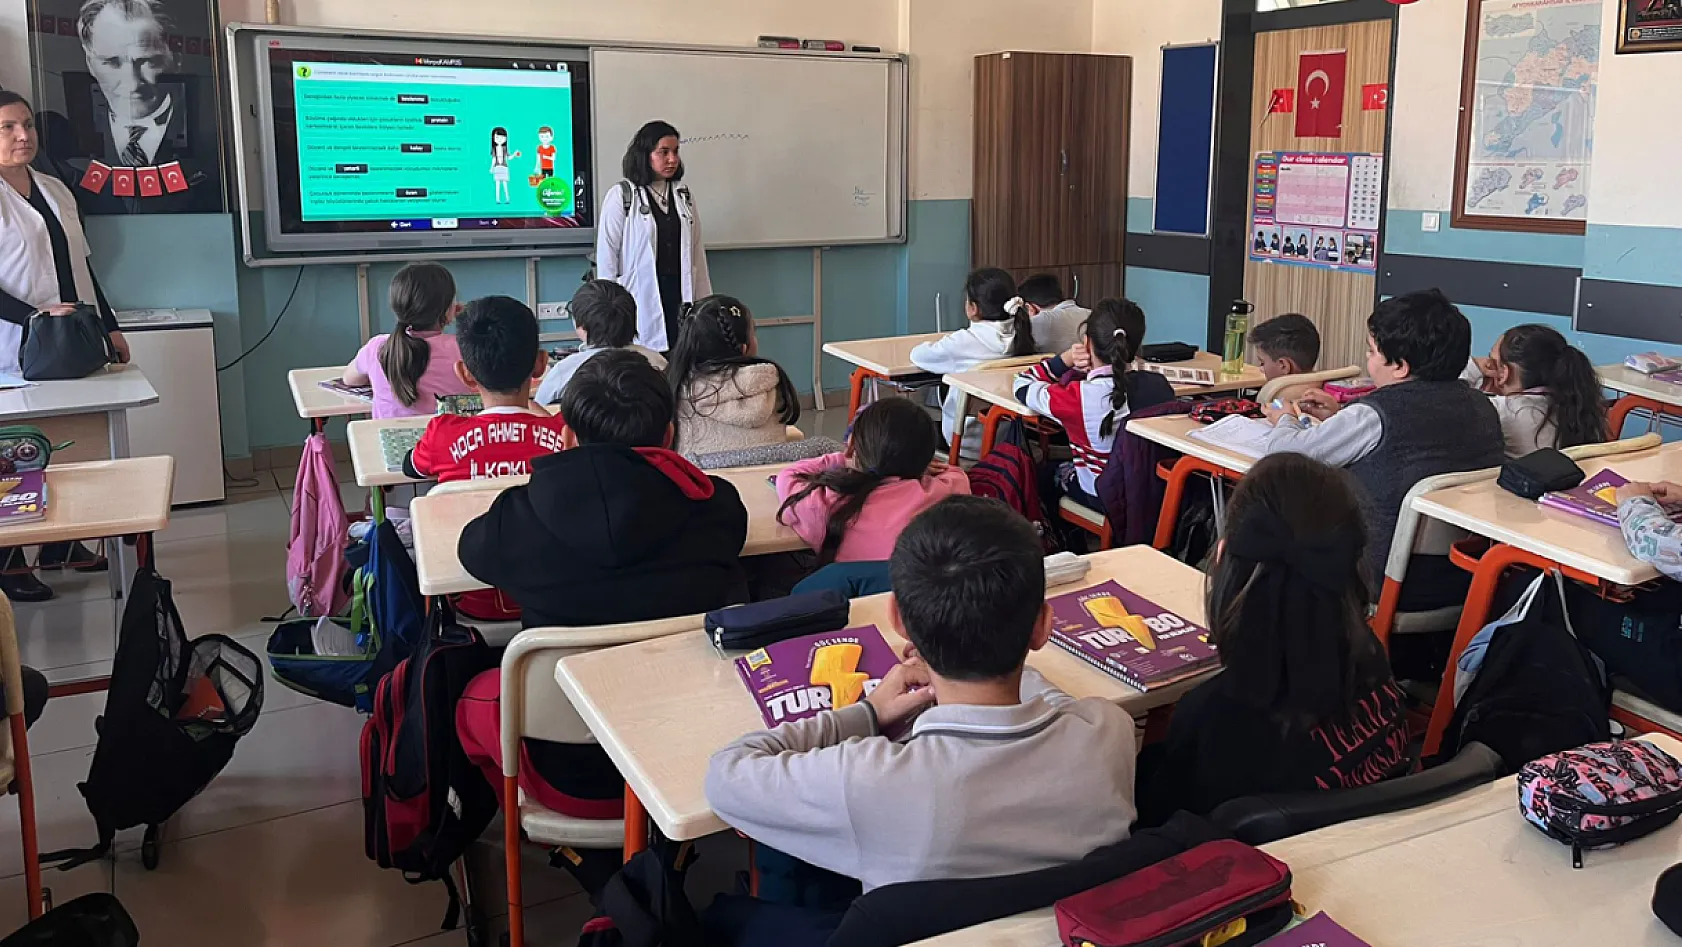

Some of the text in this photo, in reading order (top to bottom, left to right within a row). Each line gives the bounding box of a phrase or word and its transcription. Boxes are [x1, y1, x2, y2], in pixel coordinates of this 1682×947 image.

[1282, 155, 1346, 164] Our class calendar
[449, 427, 484, 464] HOCA
[488, 423, 528, 444] AHMET
